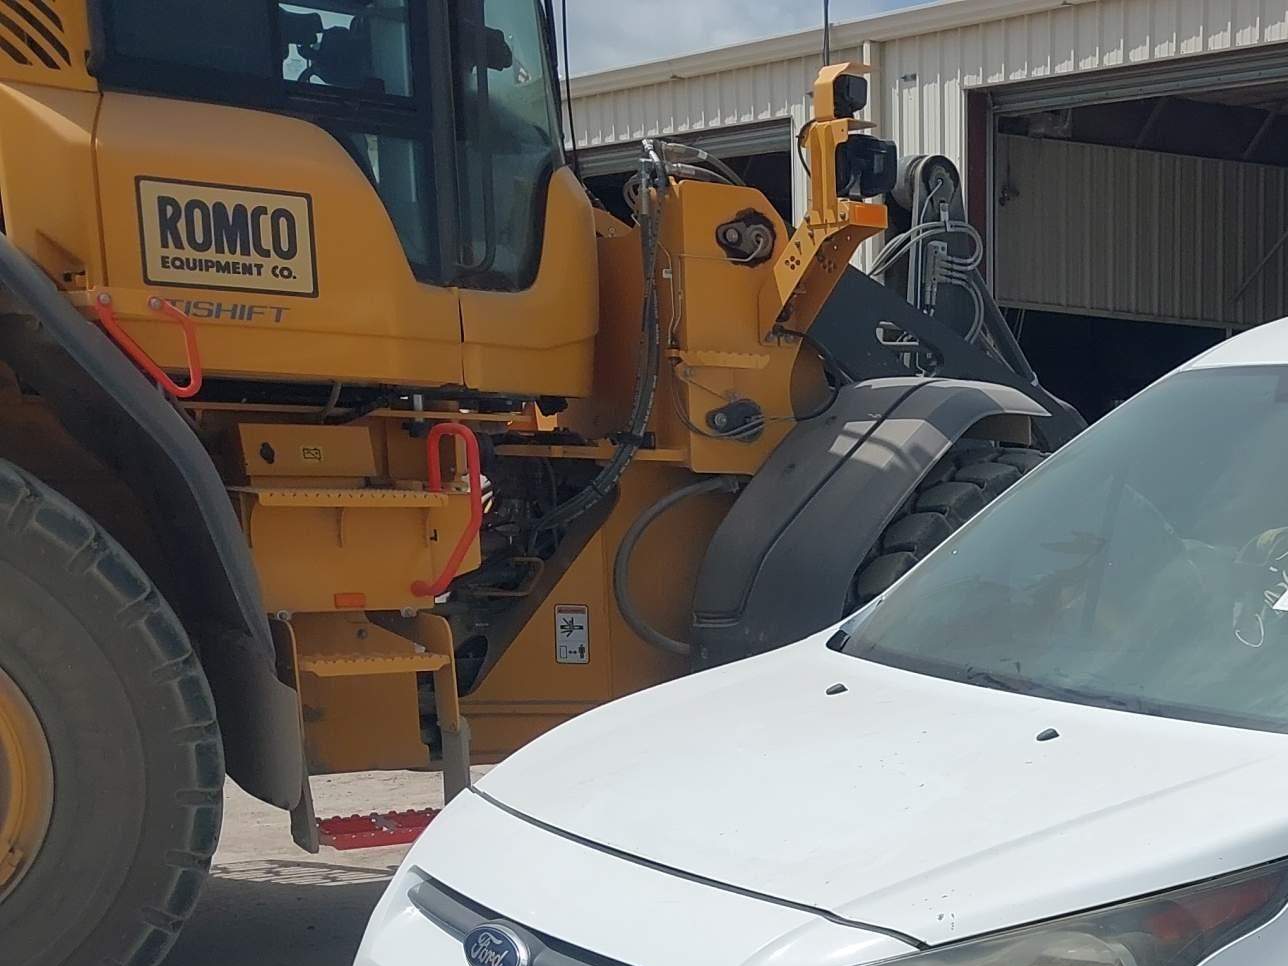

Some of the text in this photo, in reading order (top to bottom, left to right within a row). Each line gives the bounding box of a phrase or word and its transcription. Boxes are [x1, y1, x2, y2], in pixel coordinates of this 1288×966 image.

[157, 195, 298, 261] ROMCO
[160, 255, 297, 280] EQUIPMENT CO.
